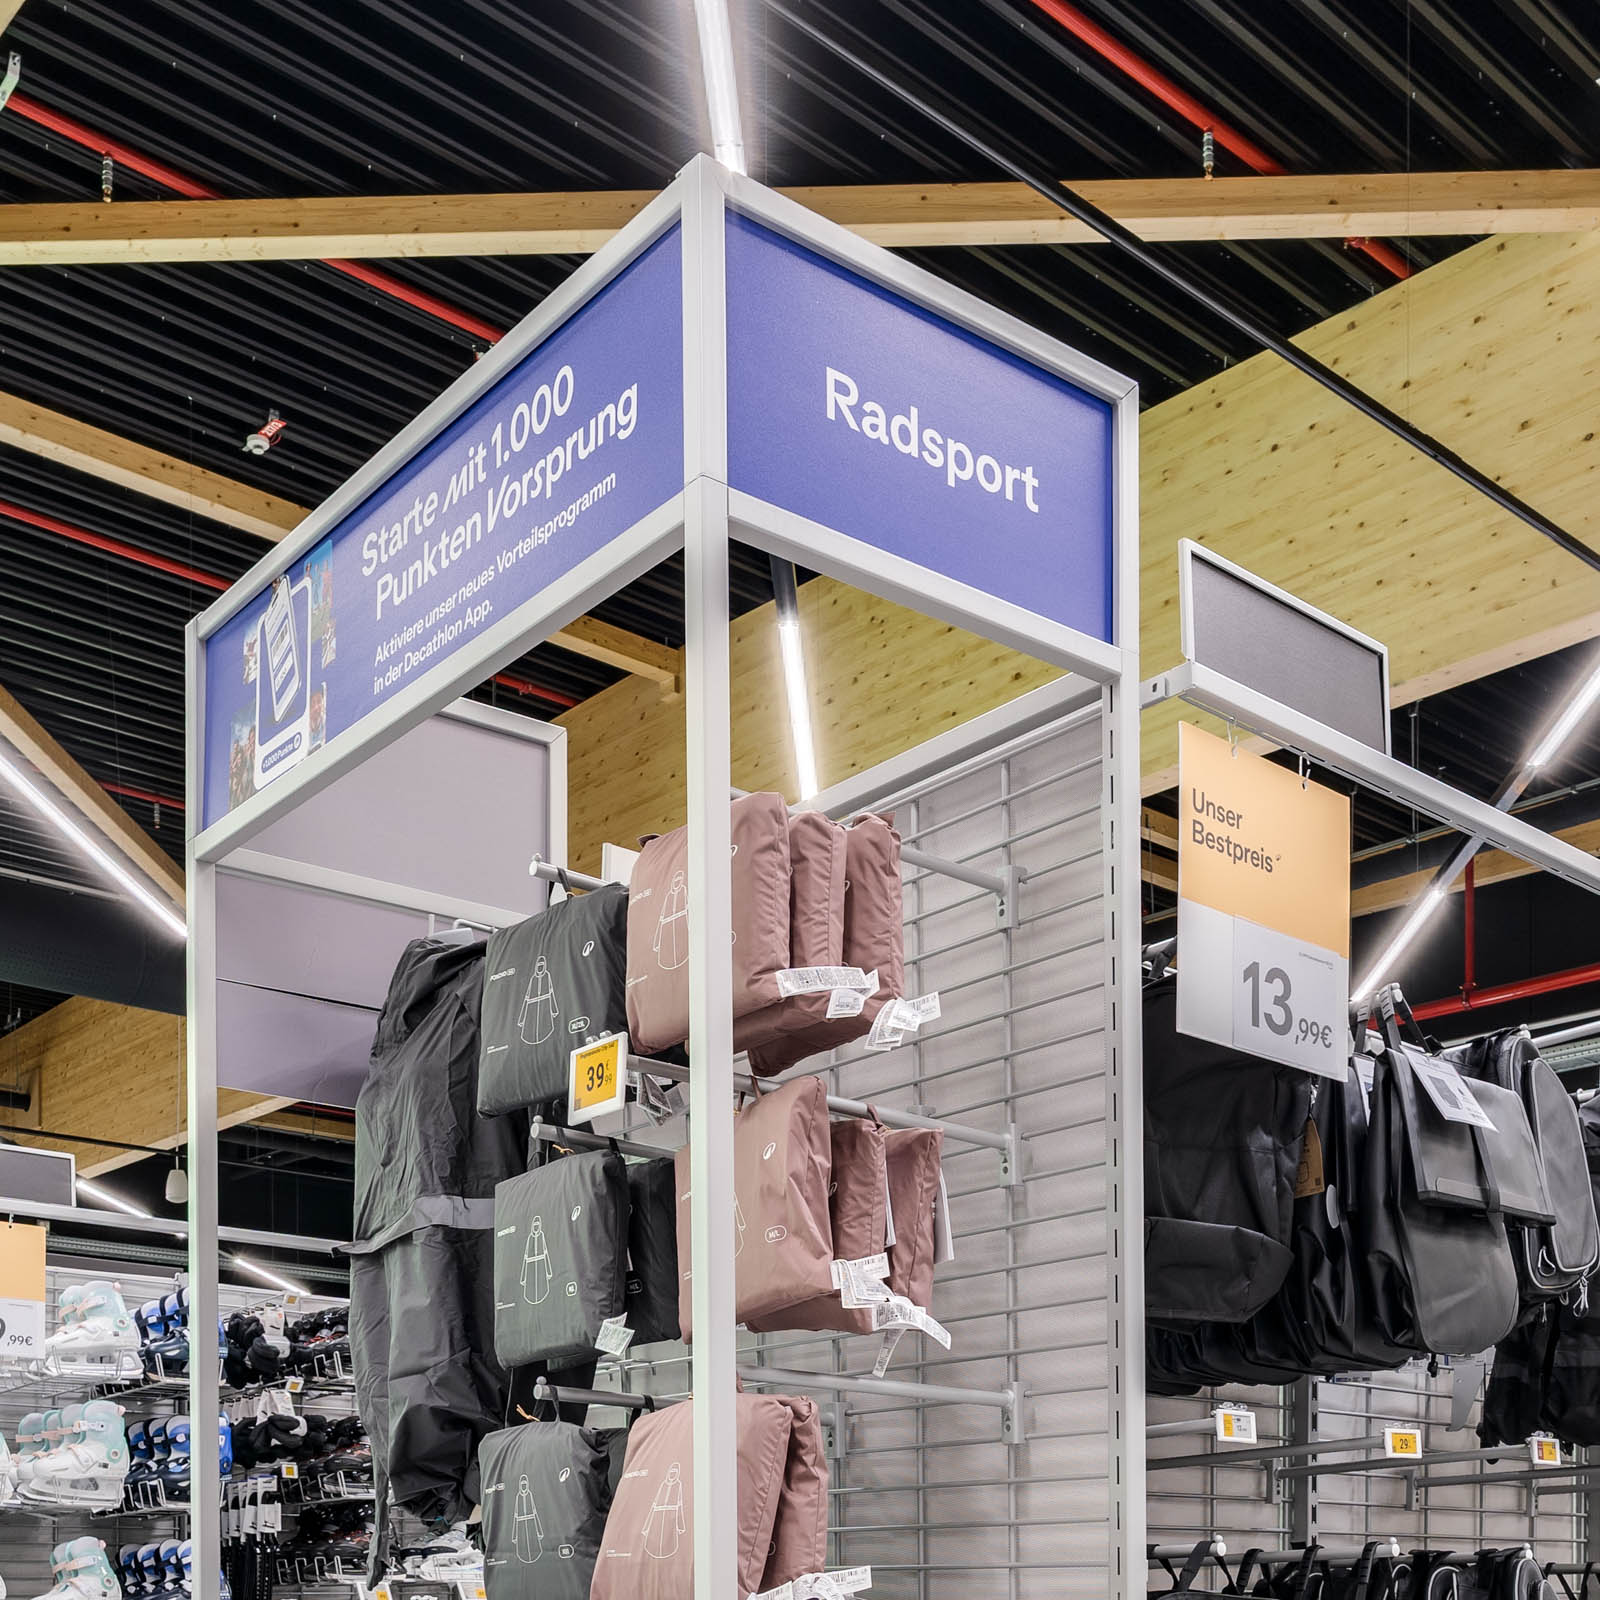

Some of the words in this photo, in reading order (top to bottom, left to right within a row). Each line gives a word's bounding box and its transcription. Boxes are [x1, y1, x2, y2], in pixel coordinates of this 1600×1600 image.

[361, 491, 438, 577] Starte
[490, 364, 574, 468] 1.000
[826, 366, 1039, 513] Radsport
[376, 511, 482, 621] Punkten
[486, 383, 638, 533] Vorsprung
[374, 616, 424, 667] Aktiviere
[424, 595, 457, 627] unser
[458, 567, 495, 602] neues
[496, 472, 616, 574] Vorteilsprogramm
[374, 675, 384, 695] in
[385, 659, 403, 687] der
[404, 620, 462, 673] Decathlon
[463, 599, 493, 634] App.
[1192, 787, 1243, 830] Unser
[1192, 819, 1273, 873] Bestpreis
[586, 1062, 605, 1093] 39
